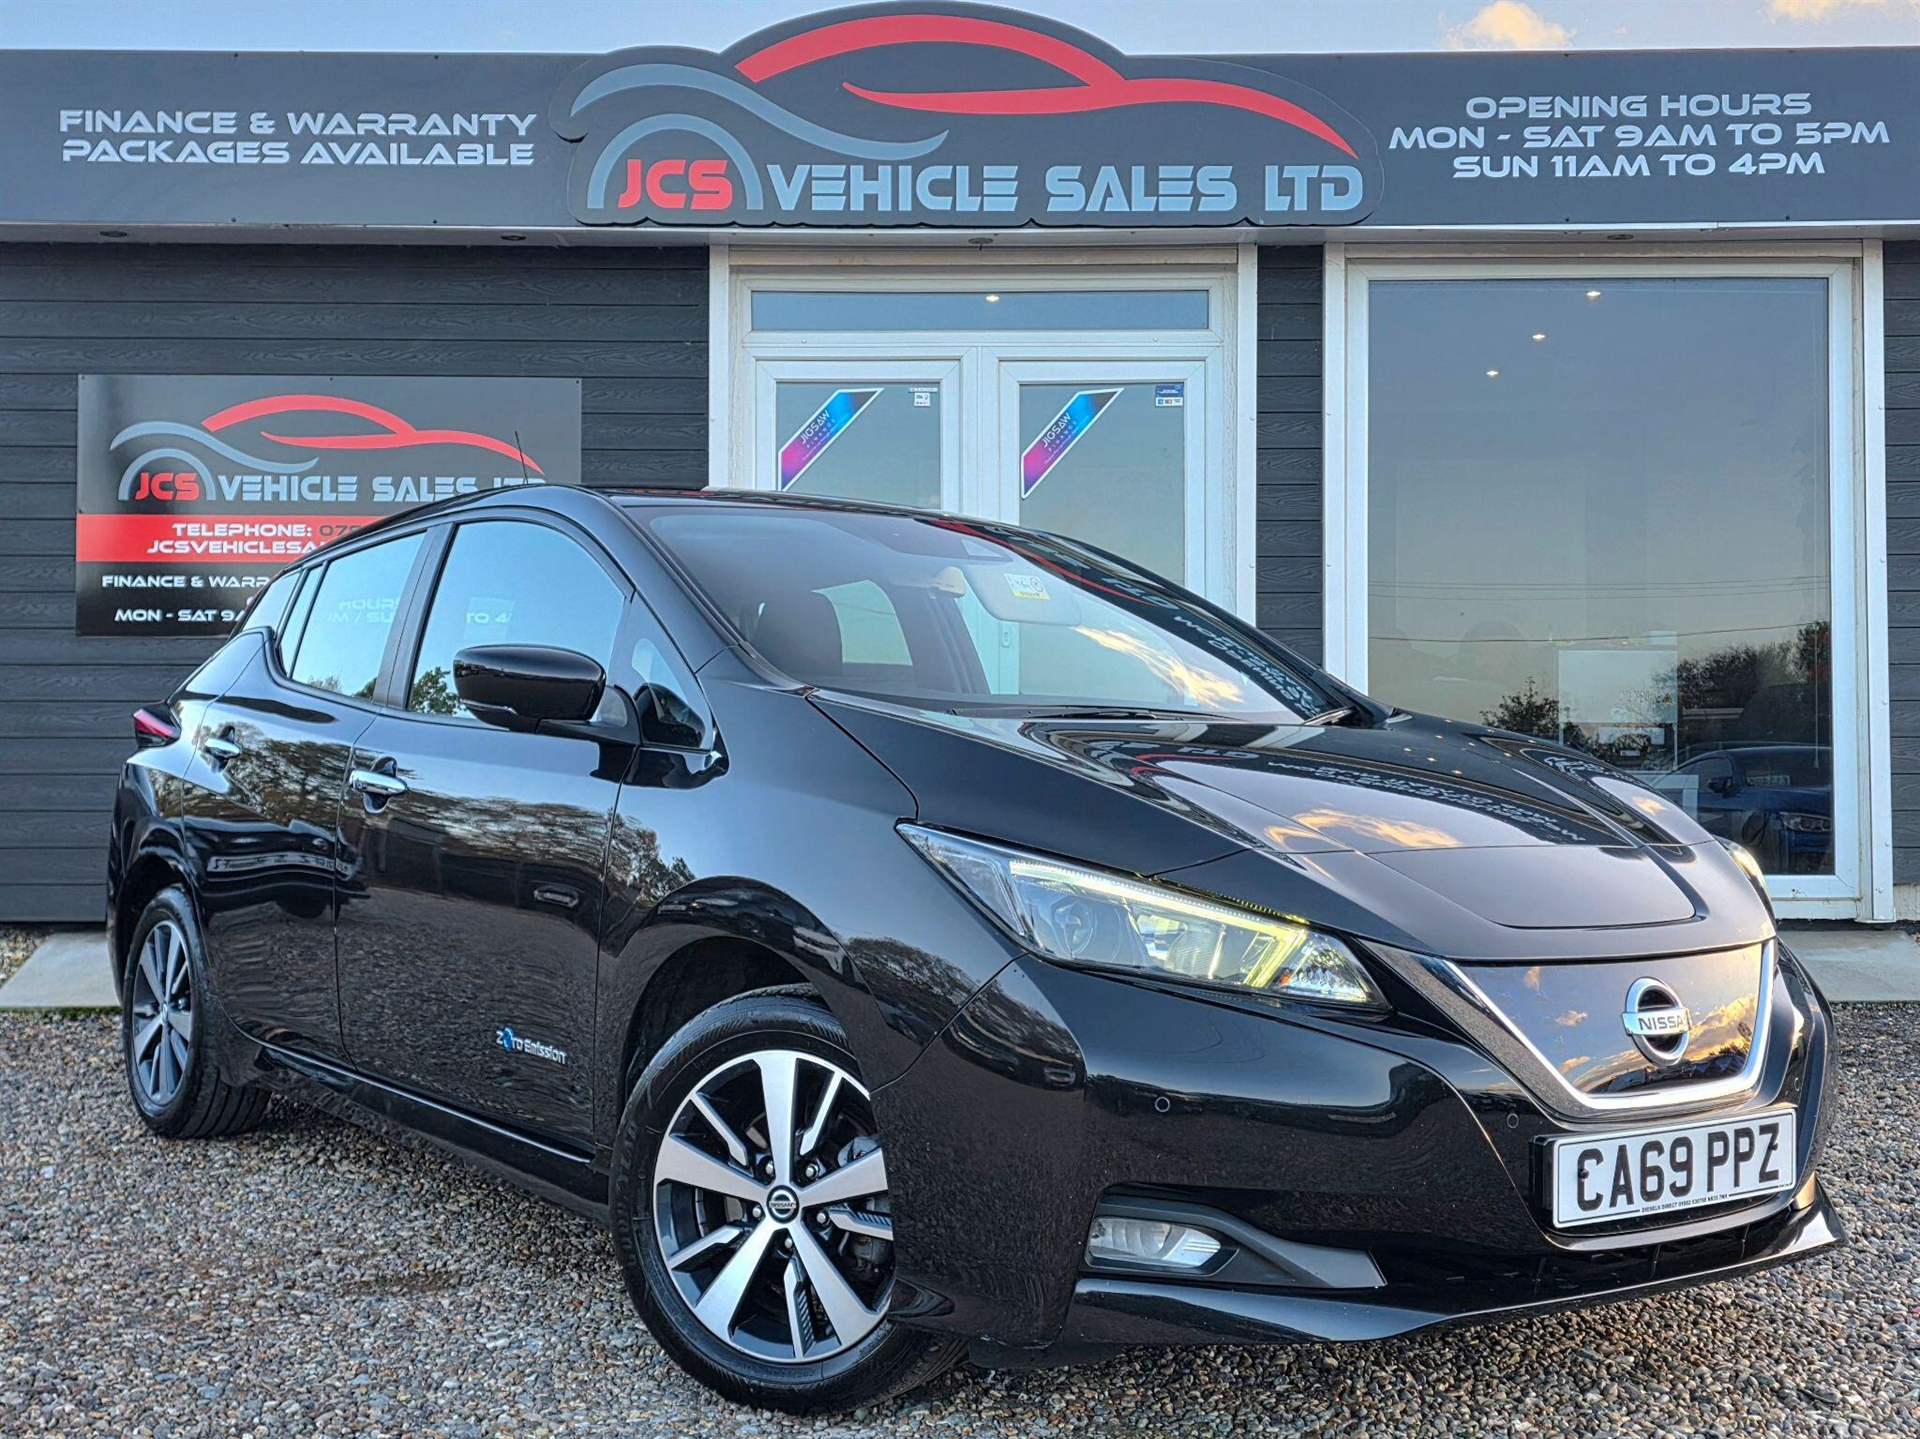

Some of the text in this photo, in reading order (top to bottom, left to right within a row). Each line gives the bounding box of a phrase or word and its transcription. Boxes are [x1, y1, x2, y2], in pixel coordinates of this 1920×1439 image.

[1466, 93, 1812, 119] OPENING HOURS
[59, 109, 537, 136] FINANCE & WARRANTY
[1389, 126, 1485, 149] MON
[1522, 125, 1606, 148] SAT
[1614, 123, 1717, 147] 9AM
[1726, 123, 1783, 146] TO
[1795, 121, 1890, 145] 5PM
[62, 139, 535, 166] PACKAGES AVAILABLE
[1452, 151, 1826, 179] SUN 11AM TO 4PM
[618, 160, 1364, 212] JCS VEHICLE SALES LTD
[800, 409, 830, 445] JIGSAW
[1042, 411, 1071, 448] JIGSAW
[135, 472, 199, 501] JCS
[217, 475, 358, 502] VEHICLE
[371, 476, 479, 502] SALES
[172, 523, 312, 537] TELEPHONE:
[146, 541, 325, 554] JCSVEHICLESA
[102, 576, 186, 588] FINANCE
[190, 575, 203, 588] &
[114, 609, 162, 622] MON
[177, 609, 217, 622] SAT
[1576, 1121, 1781, 1212] CA69 PPZ
